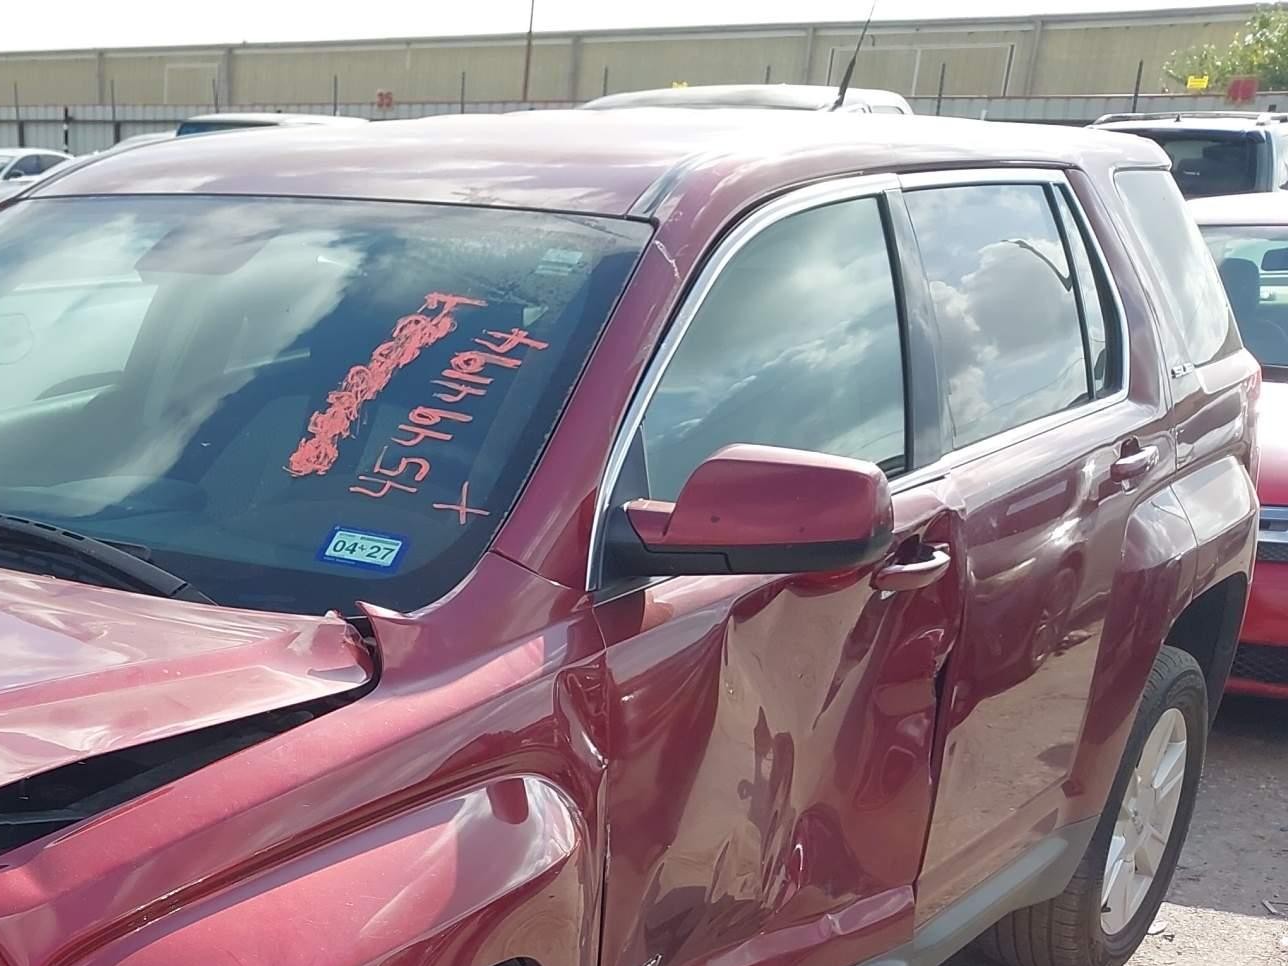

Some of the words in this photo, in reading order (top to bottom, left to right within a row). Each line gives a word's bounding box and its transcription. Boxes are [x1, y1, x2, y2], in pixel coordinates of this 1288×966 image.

[349, 327, 550, 497] 45494194
[332, 540, 359, 555] 04
[366, 545, 395, 561] 27
